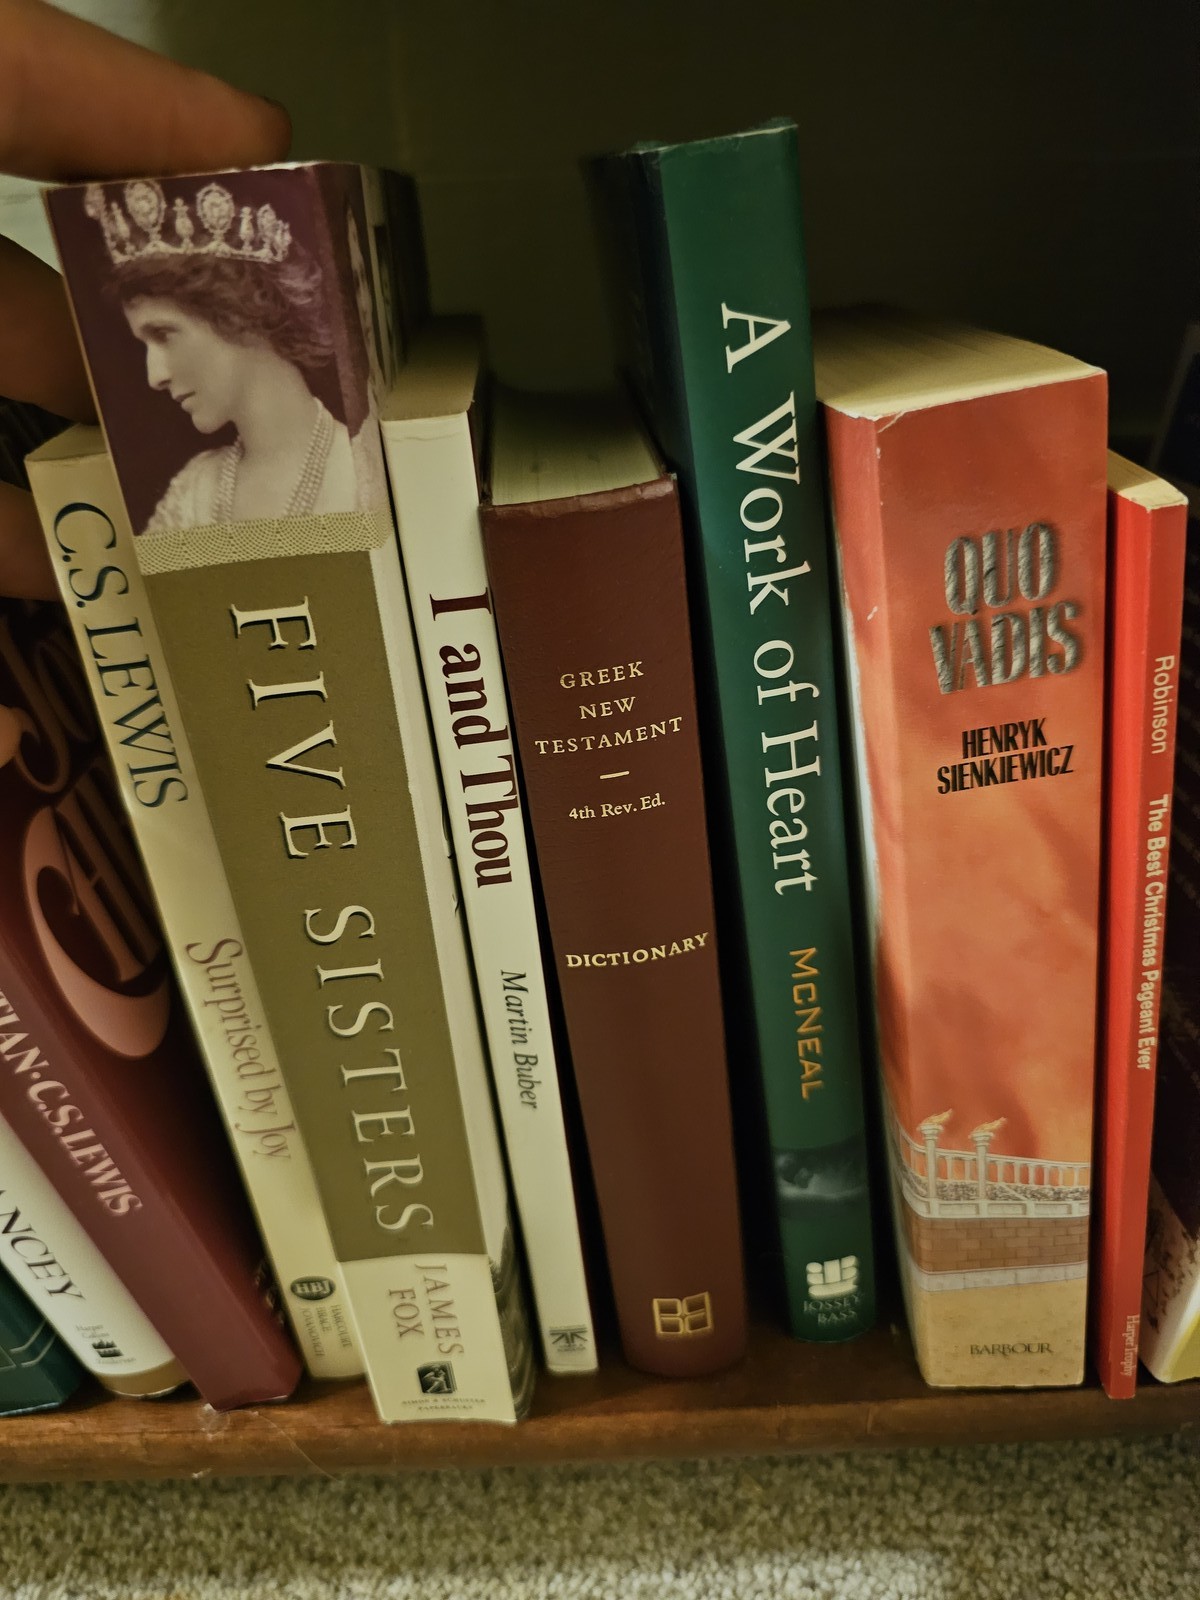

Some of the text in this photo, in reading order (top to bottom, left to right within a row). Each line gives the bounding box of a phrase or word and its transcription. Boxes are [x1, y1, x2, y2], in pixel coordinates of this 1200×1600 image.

[53, 501, 130, 609] C.S.
[720, 301, 822, 896] A Work of Heart
[943, 521, 1056, 616] QUO
[559, 660, 645, 690] GREEK
[928, 601, 1080, 695] VADIS
[84, 616, 190, 809] LEWIS
[230, 595, 358, 859] FIVE
[429, 587, 520, 889] I and Thou
[534, 716, 683, 755] TESTAMENT
[578, 696, 637, 720] NEW
[961, 717, 1048, 760] HENRYK
[1151, 655, 1175, 755] Robinson
[568, 793, 666, 820] 4th Rev. Ed.
[936, 744, 1074, 795] SIENKIEWICZ
[565, 931, 710, 968] DICTIONARY
[1136, 794, 1169, 1071] The Best Christmas Pageant Ever
[184, 937, 297, 1160] Surprised by Joy
[303, 904, 435, 1232] SISTERS
[500, 969, 542, 1110] Martin Buber
[788, 946, 825, 1100] MCNEAL
[388, 1287, 425, 1339] FOX
[414, 1263, 465, 1356] JAMES
[969, 1342, 1053, 1358] BARBOUR
